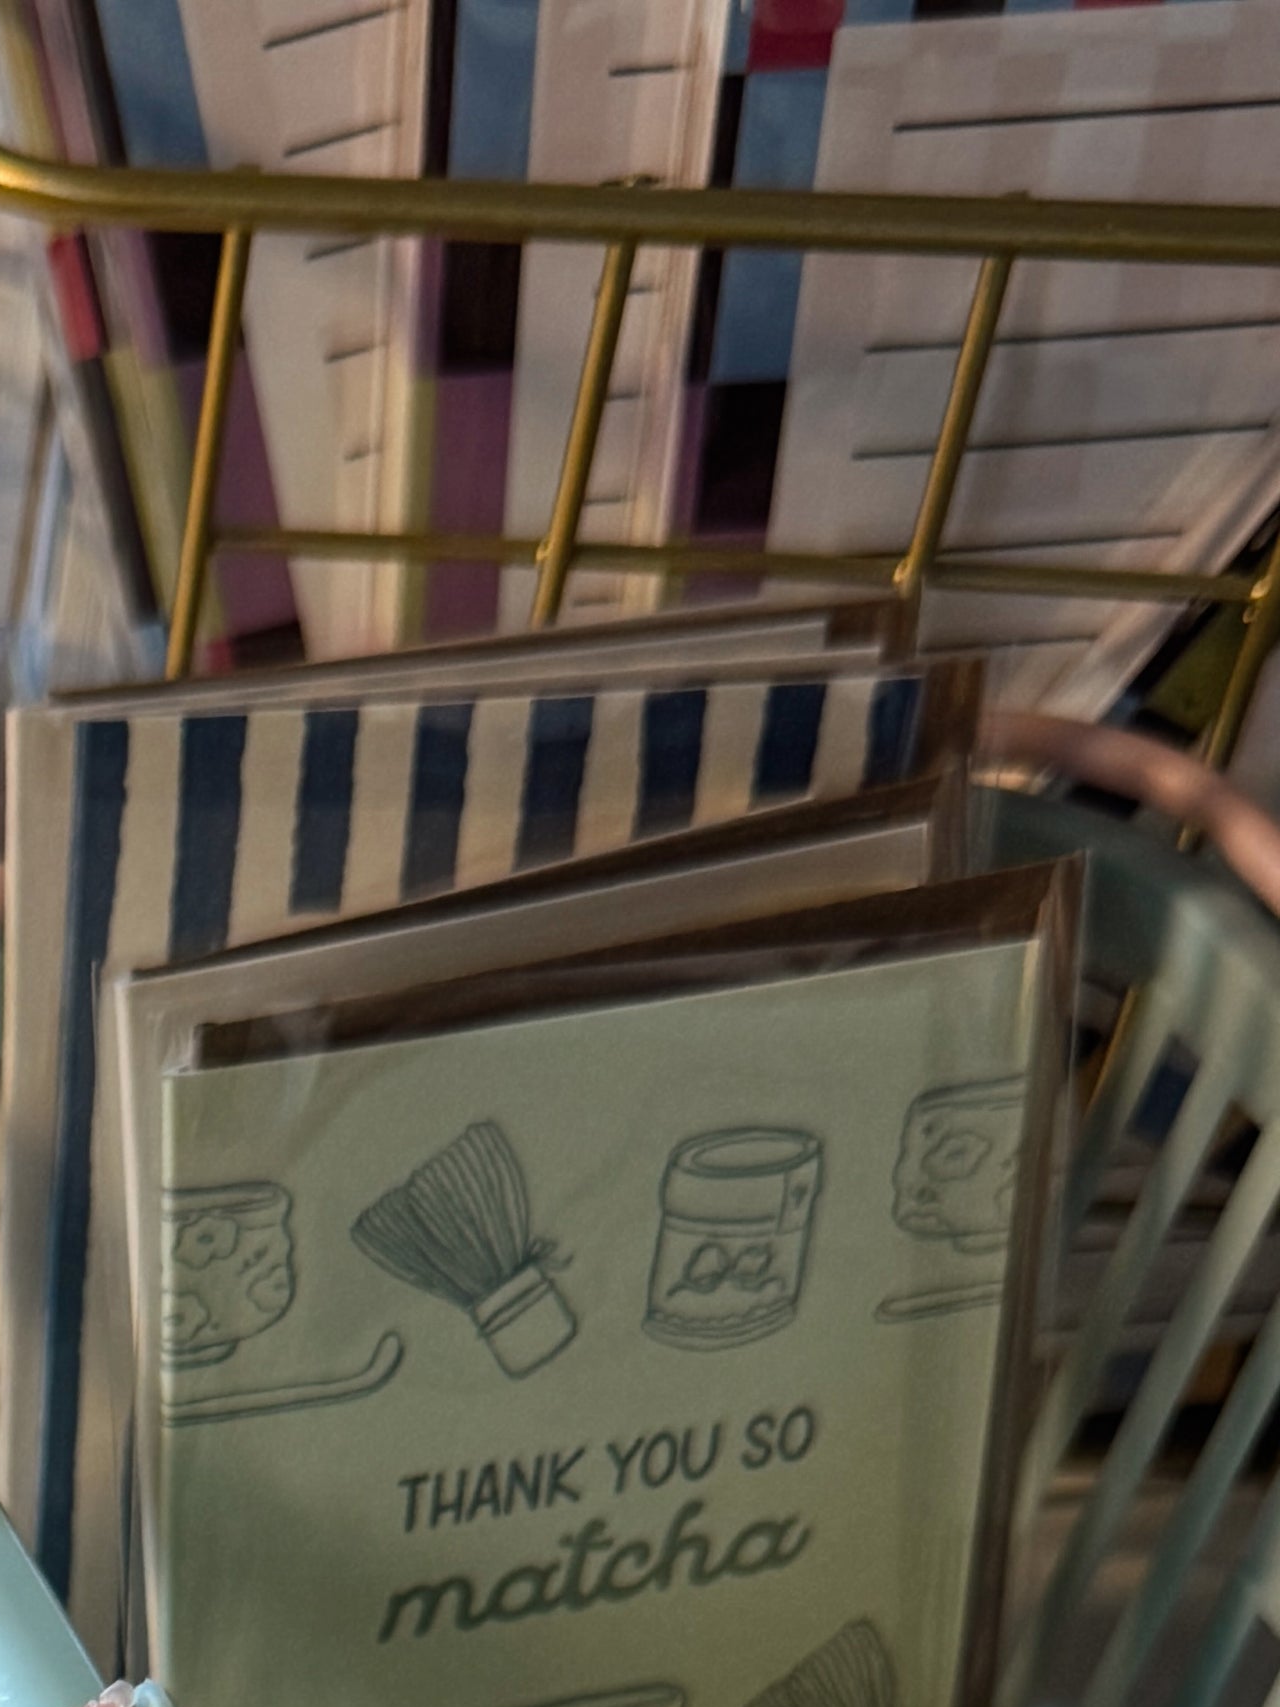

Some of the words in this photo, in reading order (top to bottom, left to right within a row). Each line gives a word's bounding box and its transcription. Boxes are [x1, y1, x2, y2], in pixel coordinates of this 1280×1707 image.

[397, 1446, 586, 1532] THANK
[605, 1421, 722, 1494] YOU
[741, 1406, 816, 1470] SO
[377, 1500, 811, 1645] matcha
